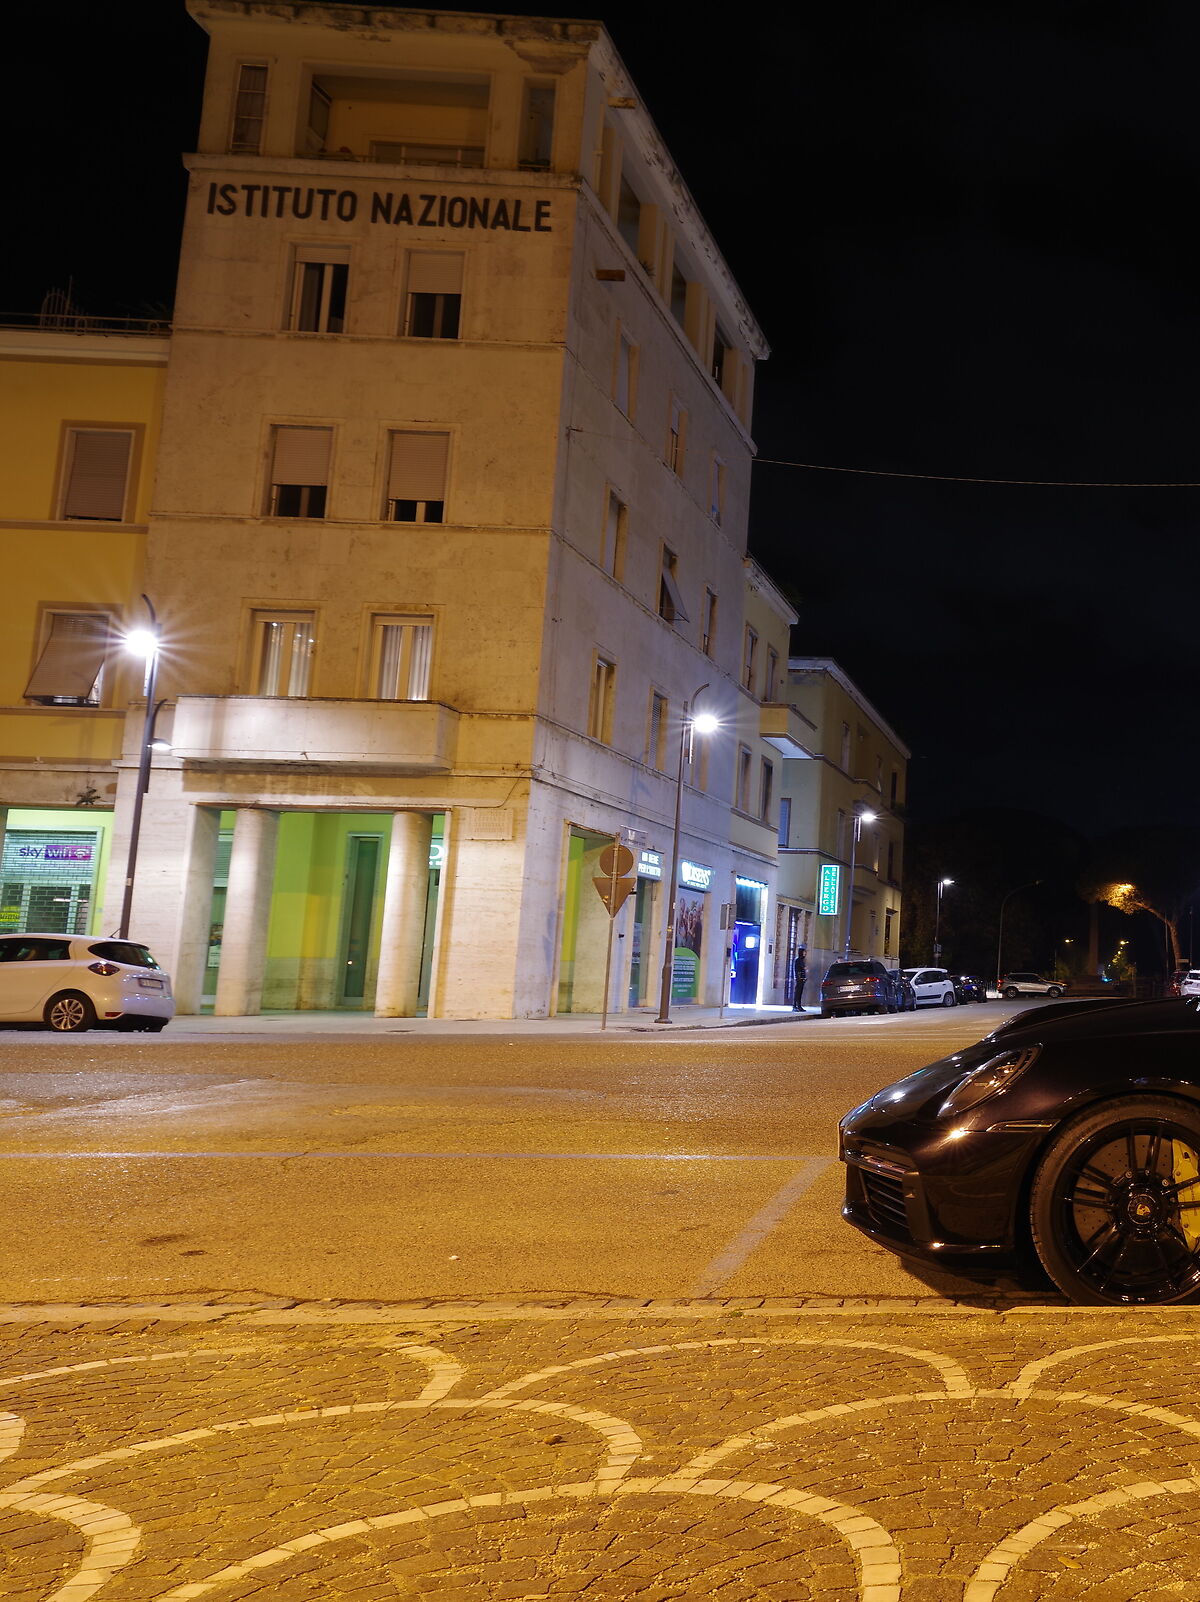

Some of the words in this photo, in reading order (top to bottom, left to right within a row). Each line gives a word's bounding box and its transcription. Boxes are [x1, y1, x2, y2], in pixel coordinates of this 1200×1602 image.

[207, 182, 358, 222] ISTITUTO
[370, 191, 553, 232] NAZIONALE
[19, 846, 42, 858] sky
[822, 869, 831, 912] ALBERGO
